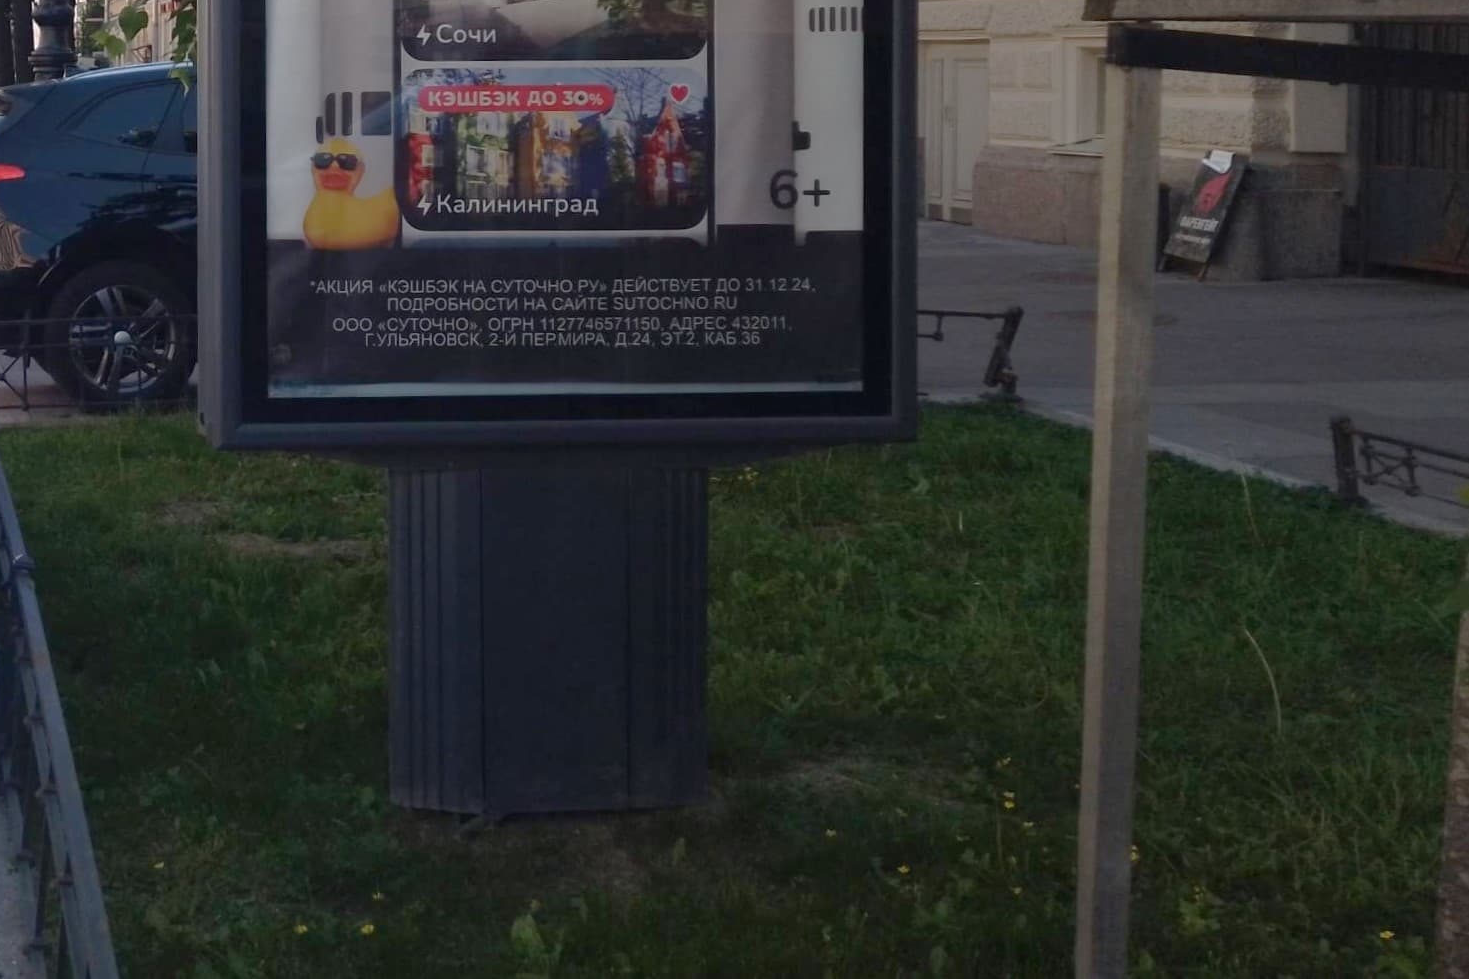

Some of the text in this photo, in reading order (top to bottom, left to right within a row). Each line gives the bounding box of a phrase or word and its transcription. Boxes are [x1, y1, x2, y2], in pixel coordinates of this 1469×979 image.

[436, 24, 497, 44] Сочи
[427, 90, 604, 108] КЭШБЭК ДО 30%
[769, 169, 830, 209] 6+
[436, 193, 599, 218] Калининград
[380, 279, 459, 294] «КЭШБЭК
[463, 279, 487, 294] НА
[611, 276, 711, 295] ДЕЙСТВУЕТ
[716, 278, 741, 295] ДО
[387, 297, 518, 313] ПОДРОБНОСТИ
[523, 297, 548, 312] НА
[551, 294, 609, 312] САЙТЕ
[332, 317, 373, 332] ООО
[487, 317, 534, 332] ОГРН
[669, 316, 727, 332] АДРЕС
[489, 329, 516, 347] 2-Й
